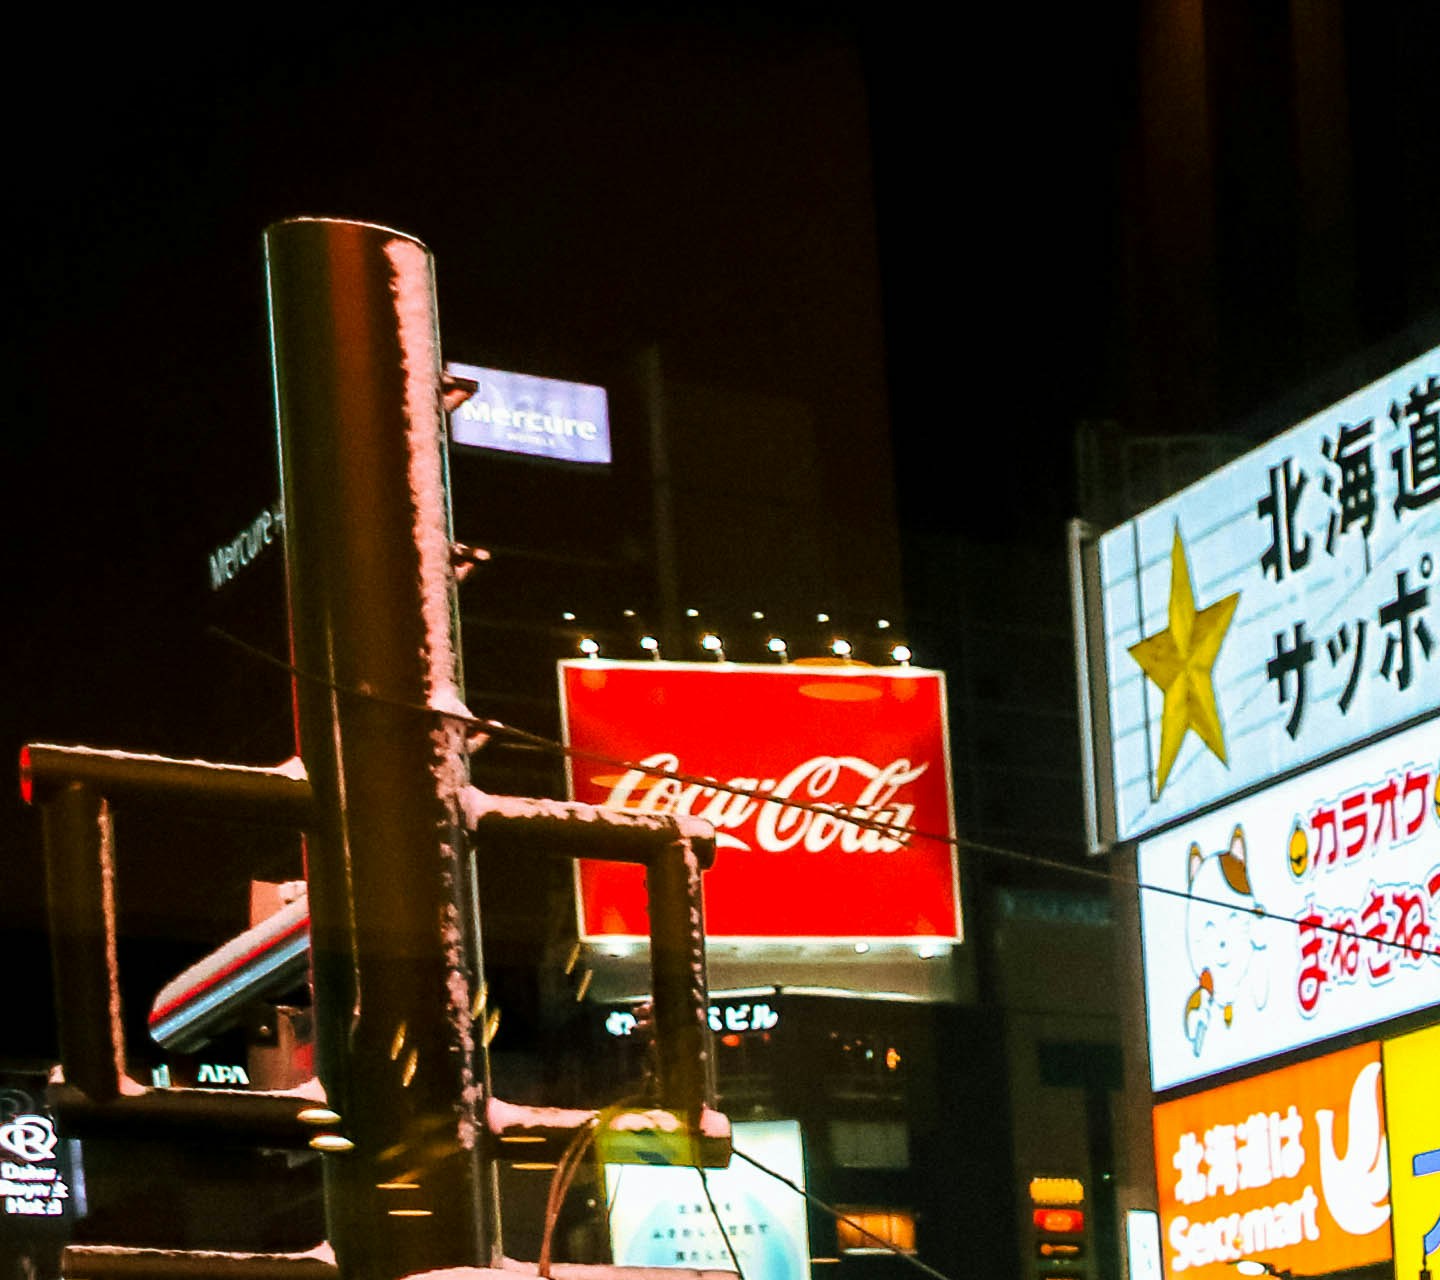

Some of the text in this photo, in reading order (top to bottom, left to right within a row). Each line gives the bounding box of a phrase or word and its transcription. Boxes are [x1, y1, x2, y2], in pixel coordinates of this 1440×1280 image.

[463, 401, 598, 442] Mercure
[609, 753, 928, 856] Coca-Cola
[1312, 771, 1431, 868] カラオケ
[198, 1064, 250, 1085] APA
